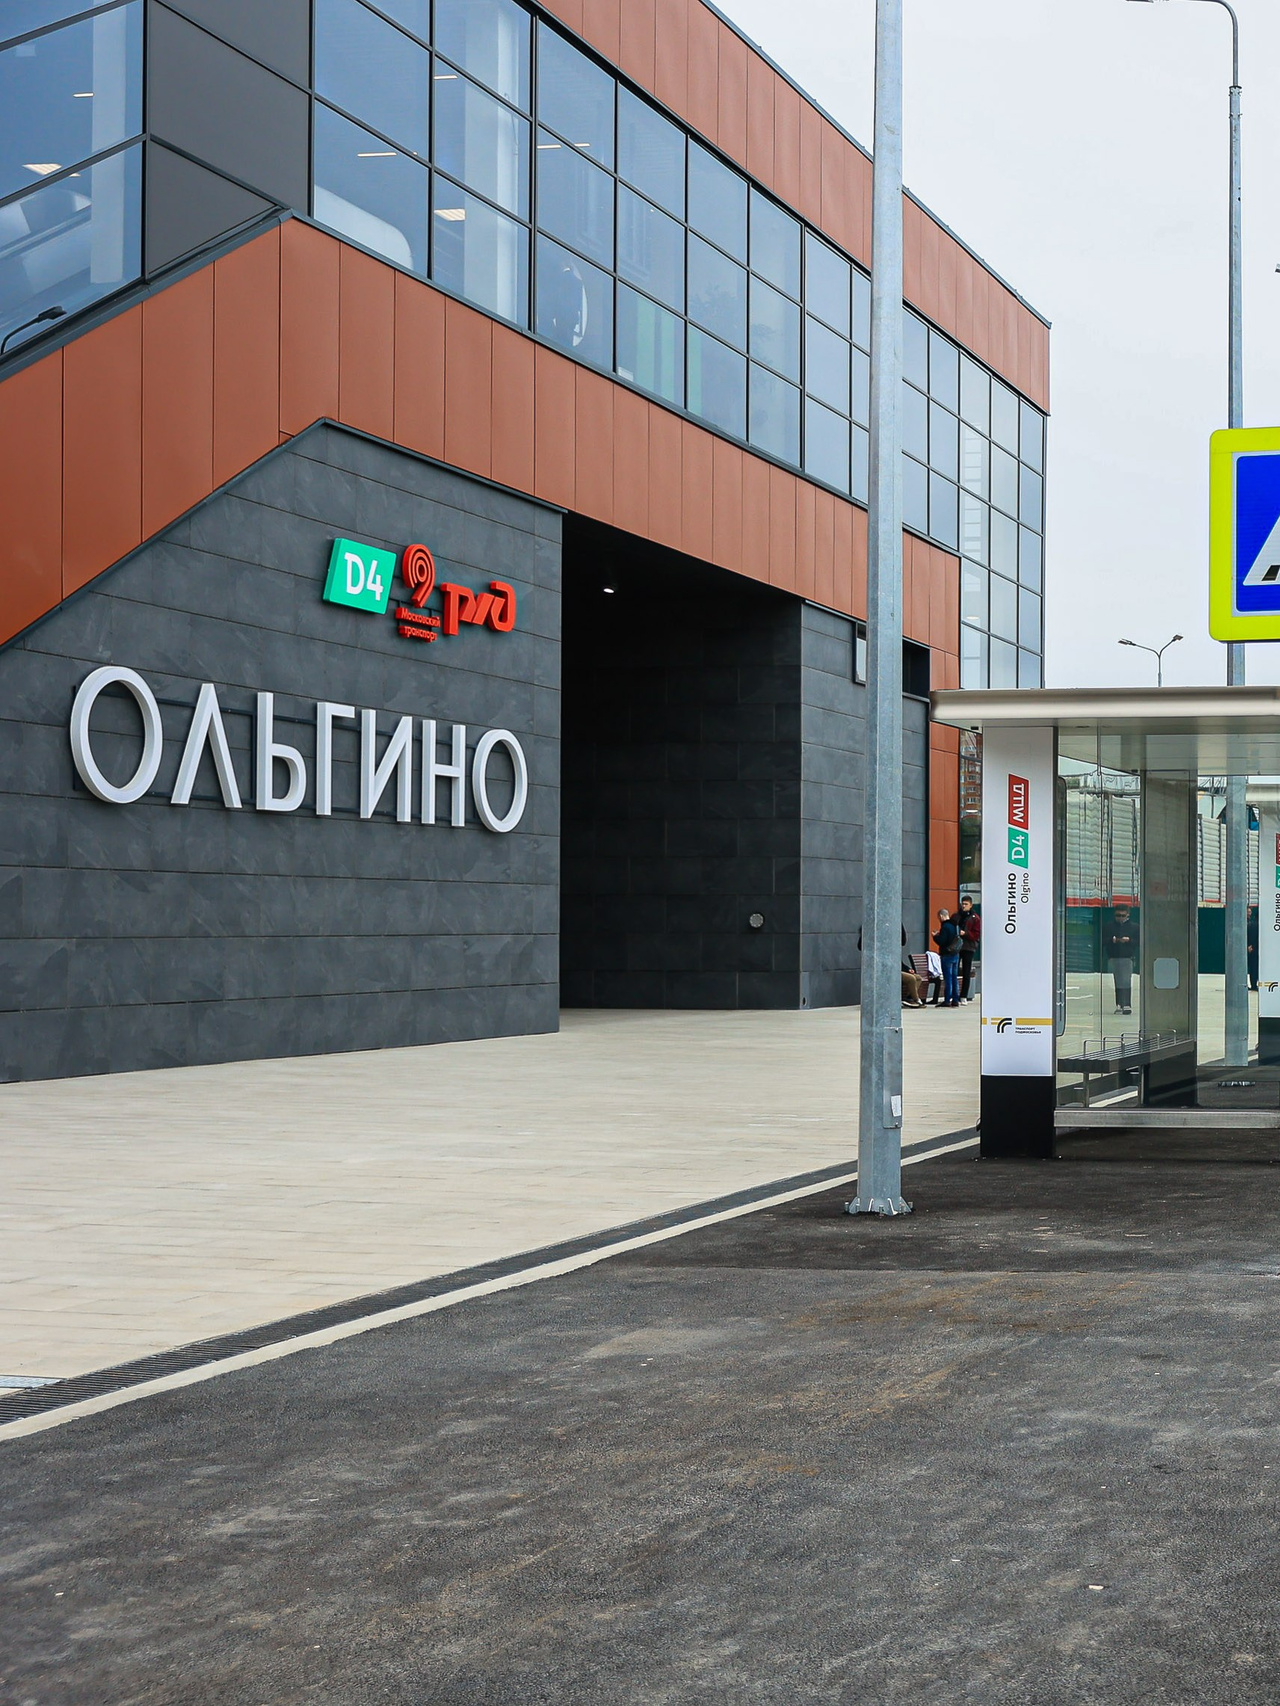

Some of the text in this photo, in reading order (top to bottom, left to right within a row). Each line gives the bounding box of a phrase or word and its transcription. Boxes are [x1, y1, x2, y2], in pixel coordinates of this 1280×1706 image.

[344, 551, 384, 601] D4
[398, 607, 441, 628] Московский
[69, 665, 529, 833] ОЛЬГИНО
[1005, 783, 1025, 934] Ольгино D4 МЦД
[1020, 872, 1031, 904] Olgino
